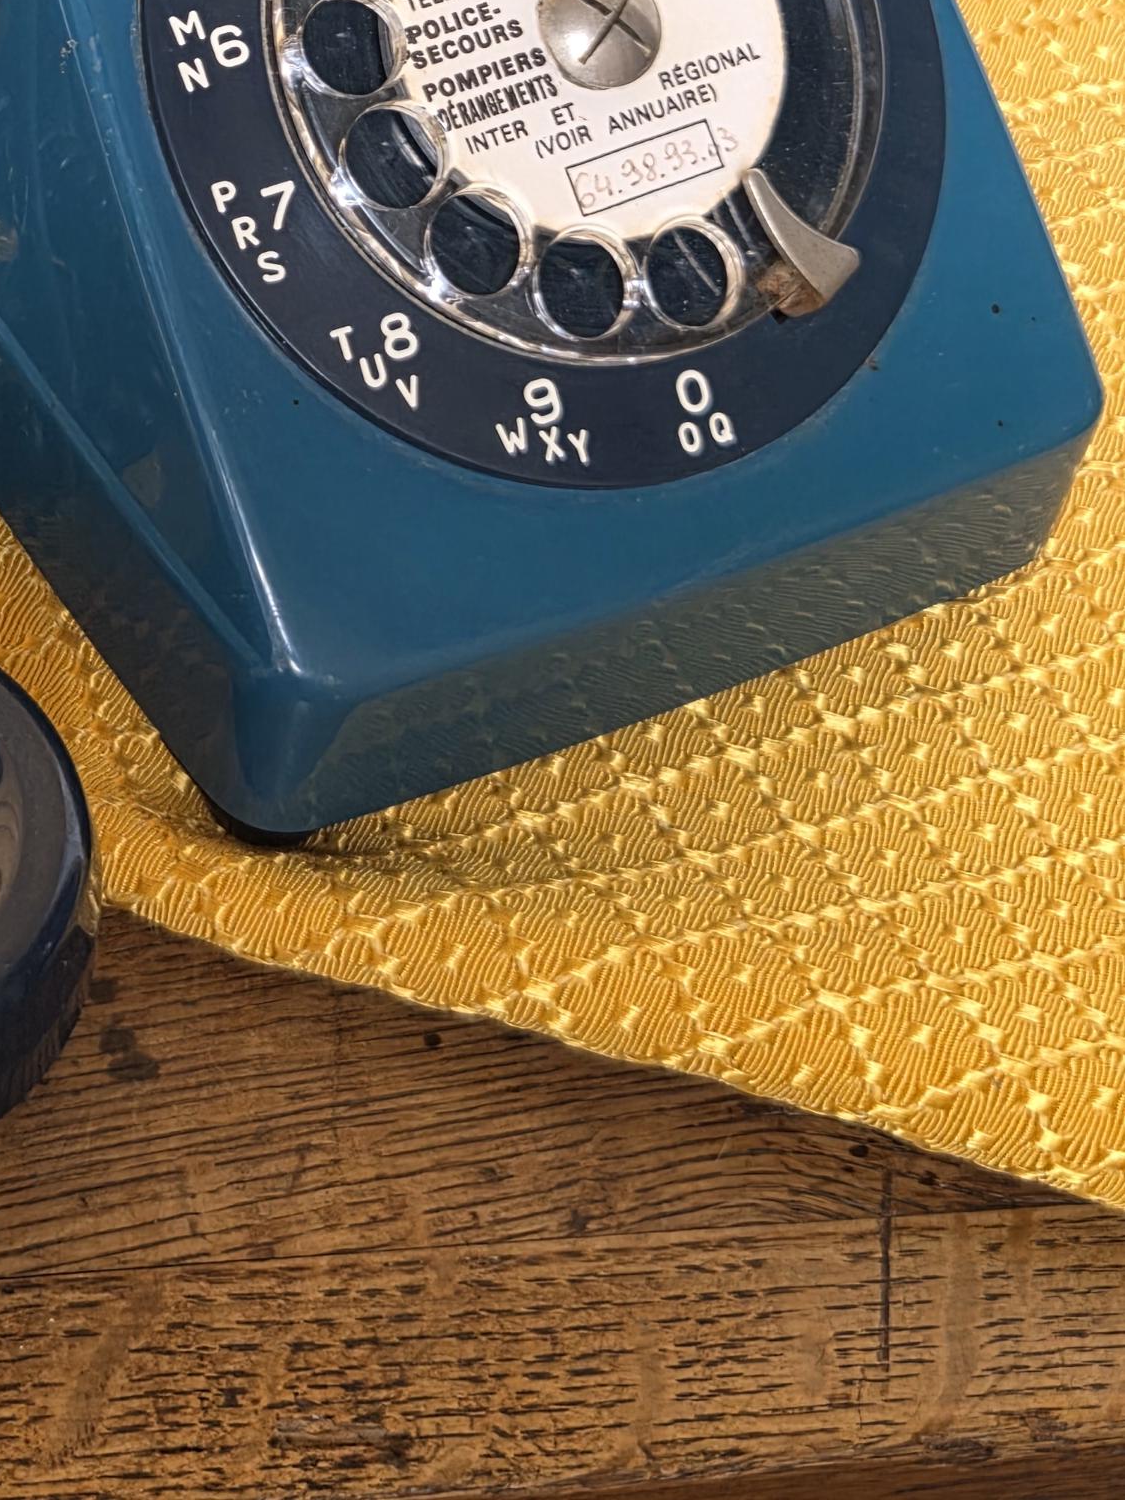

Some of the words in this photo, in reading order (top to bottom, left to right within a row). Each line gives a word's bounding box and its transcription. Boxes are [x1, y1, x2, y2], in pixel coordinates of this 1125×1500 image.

[210, 24, 250, 68] 6
[405, 2, 501, 45] POLICE-
[410, 19, 524, 69] SECOURS
[422, 48, 547, 103] POMPIERS
[465, 119, 529, 155] INTER
[550, 102, 575, 126] ET
[658, 43, 761, 91] RÉGIONAL
[535, 124, 593, 159] (VOIR
[608, 83, 717, 135] ANNUAIRE)
[260, 180, 295, 230] 7
[380, 312, 420, 360] 8
[329, 325, 420, 411] TUV
[675, 369, 713, 415] 0
[523, 377, 563, 426] 9
[495, 417, 593, 467] WXY
